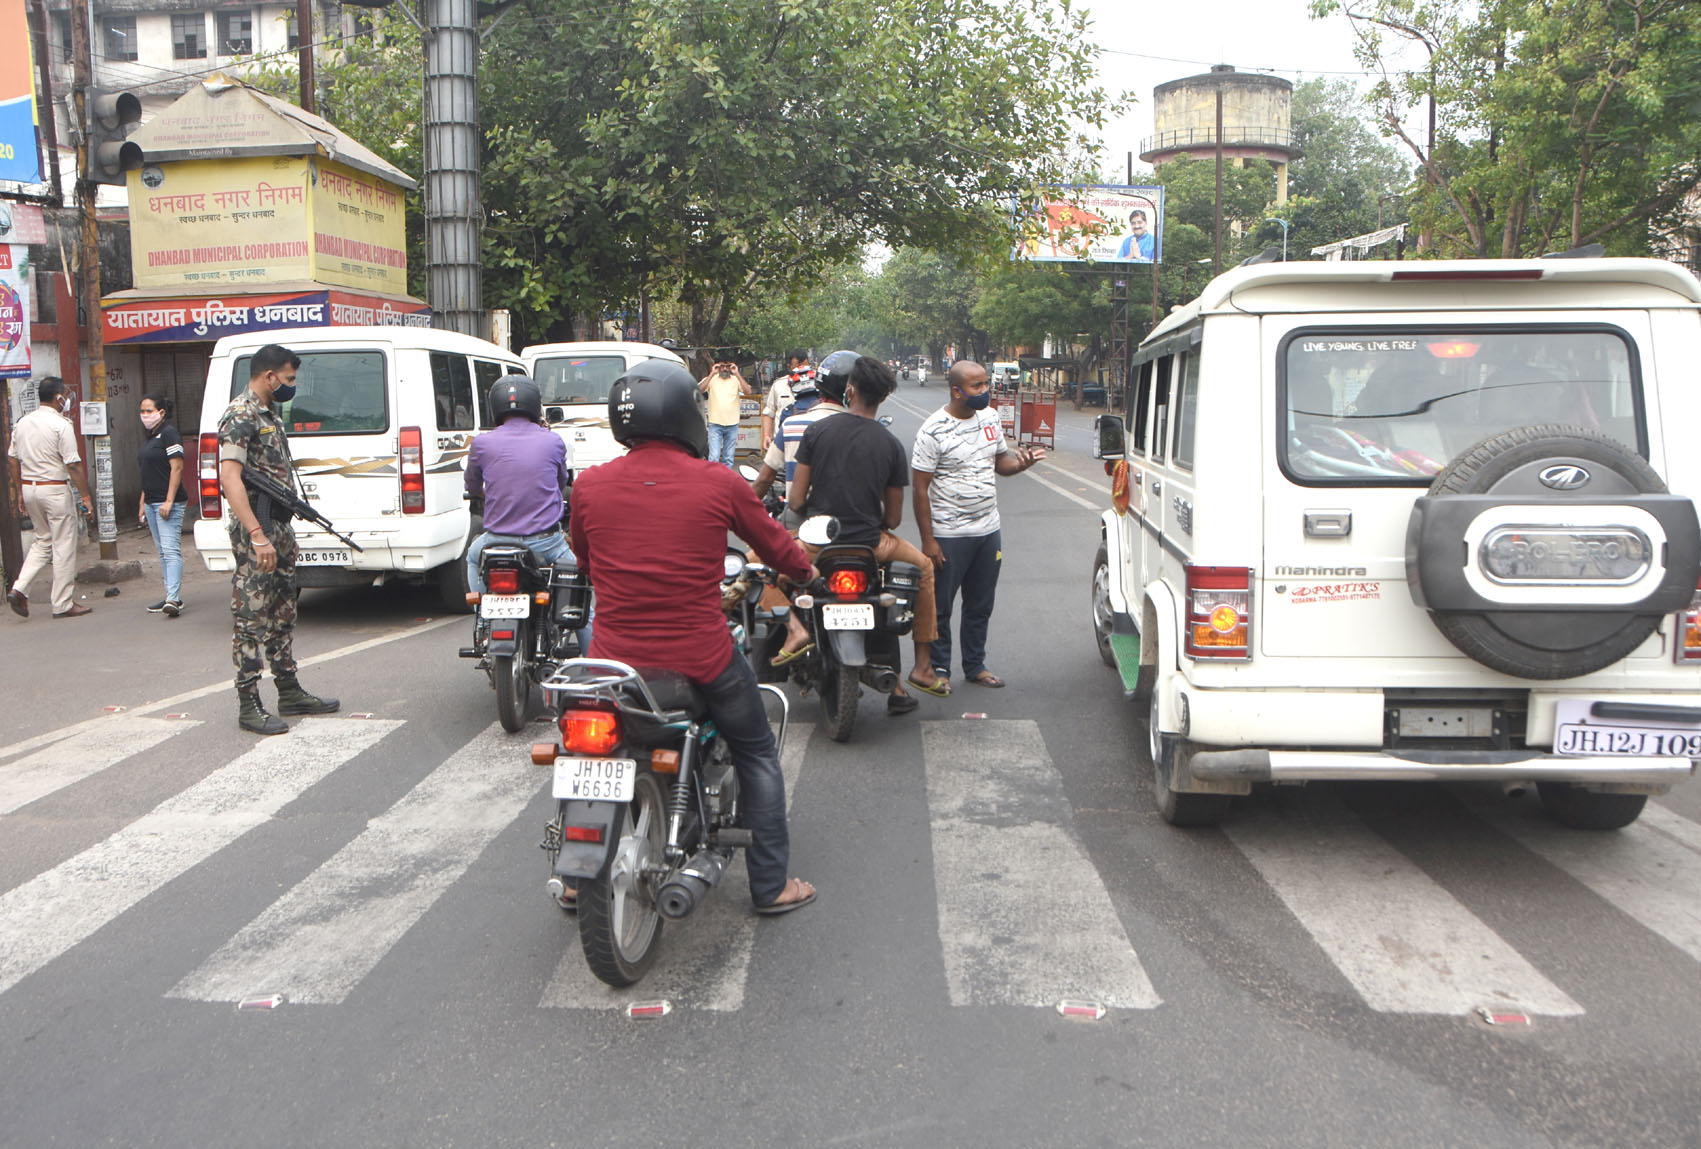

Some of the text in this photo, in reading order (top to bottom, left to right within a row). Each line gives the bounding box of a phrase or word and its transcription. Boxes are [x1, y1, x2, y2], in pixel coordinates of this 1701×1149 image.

[148, 181, 303, 214] धनबाद नगर निगम
[199, 213, 221, 222] धनबाद
[252, 210, 275, 219] धनबाद
[148, 241, 309, 267] DHANBAD MUNICIPAL CORPORATION
[107, 300, 325, 335] यातायात पुलिस धनबाद
[332, 303, 374, 326] यातायात
[1303, 342, 1327, 352] LIVE
[1368, 341, 1390, 351] LIVE
[322, 552, 348, 562] 0978
[1563, 729, 1648, 754] JH.12J
[574, 761, 625, 779] JH10B
[572, 780, 623, 798] W6636
